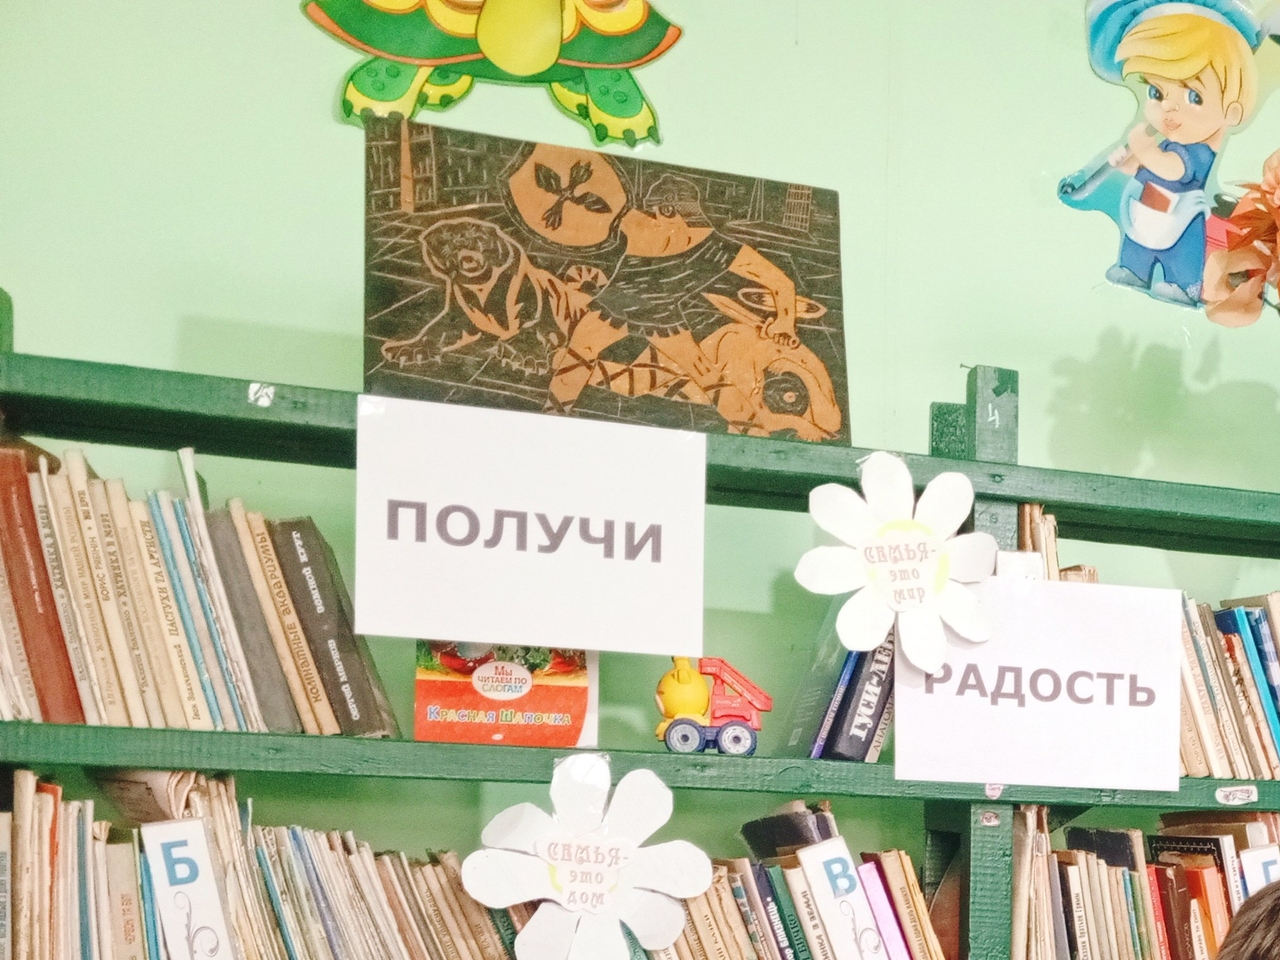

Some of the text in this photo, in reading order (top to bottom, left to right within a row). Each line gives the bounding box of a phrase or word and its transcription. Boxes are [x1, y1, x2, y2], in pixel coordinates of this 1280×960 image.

[988, 403, 999, 428] 4
[139, 517, 160, 568] АРТИСТИ
[386, 499, 663, 563] ПОЛУЧИ
[46, 541, 65, 591] ХАТИНКА
[72, 543, 86, 577] НАШЕЙ
[108, 550, 127, 599] ХАТИНКА
[96, 571, 111, 602] БОРИС
[84, 601, 102, 652] ЖИВОТНЫЙ
[477, 675, 527, 685] ЧИТАЕМ ПО
[481, 683, 523, 693] СЛОГАМ
[923, 662, 1157, 708] РАДОСТЬ
[161, 840, 199, 887] Б
[823, 857, 857, 898] В
[702, 914, 719, 944] КАЗКИ
[785, 913, 808, 954] БИЧКО
[1079, 940, 1088, 960] Сказки
